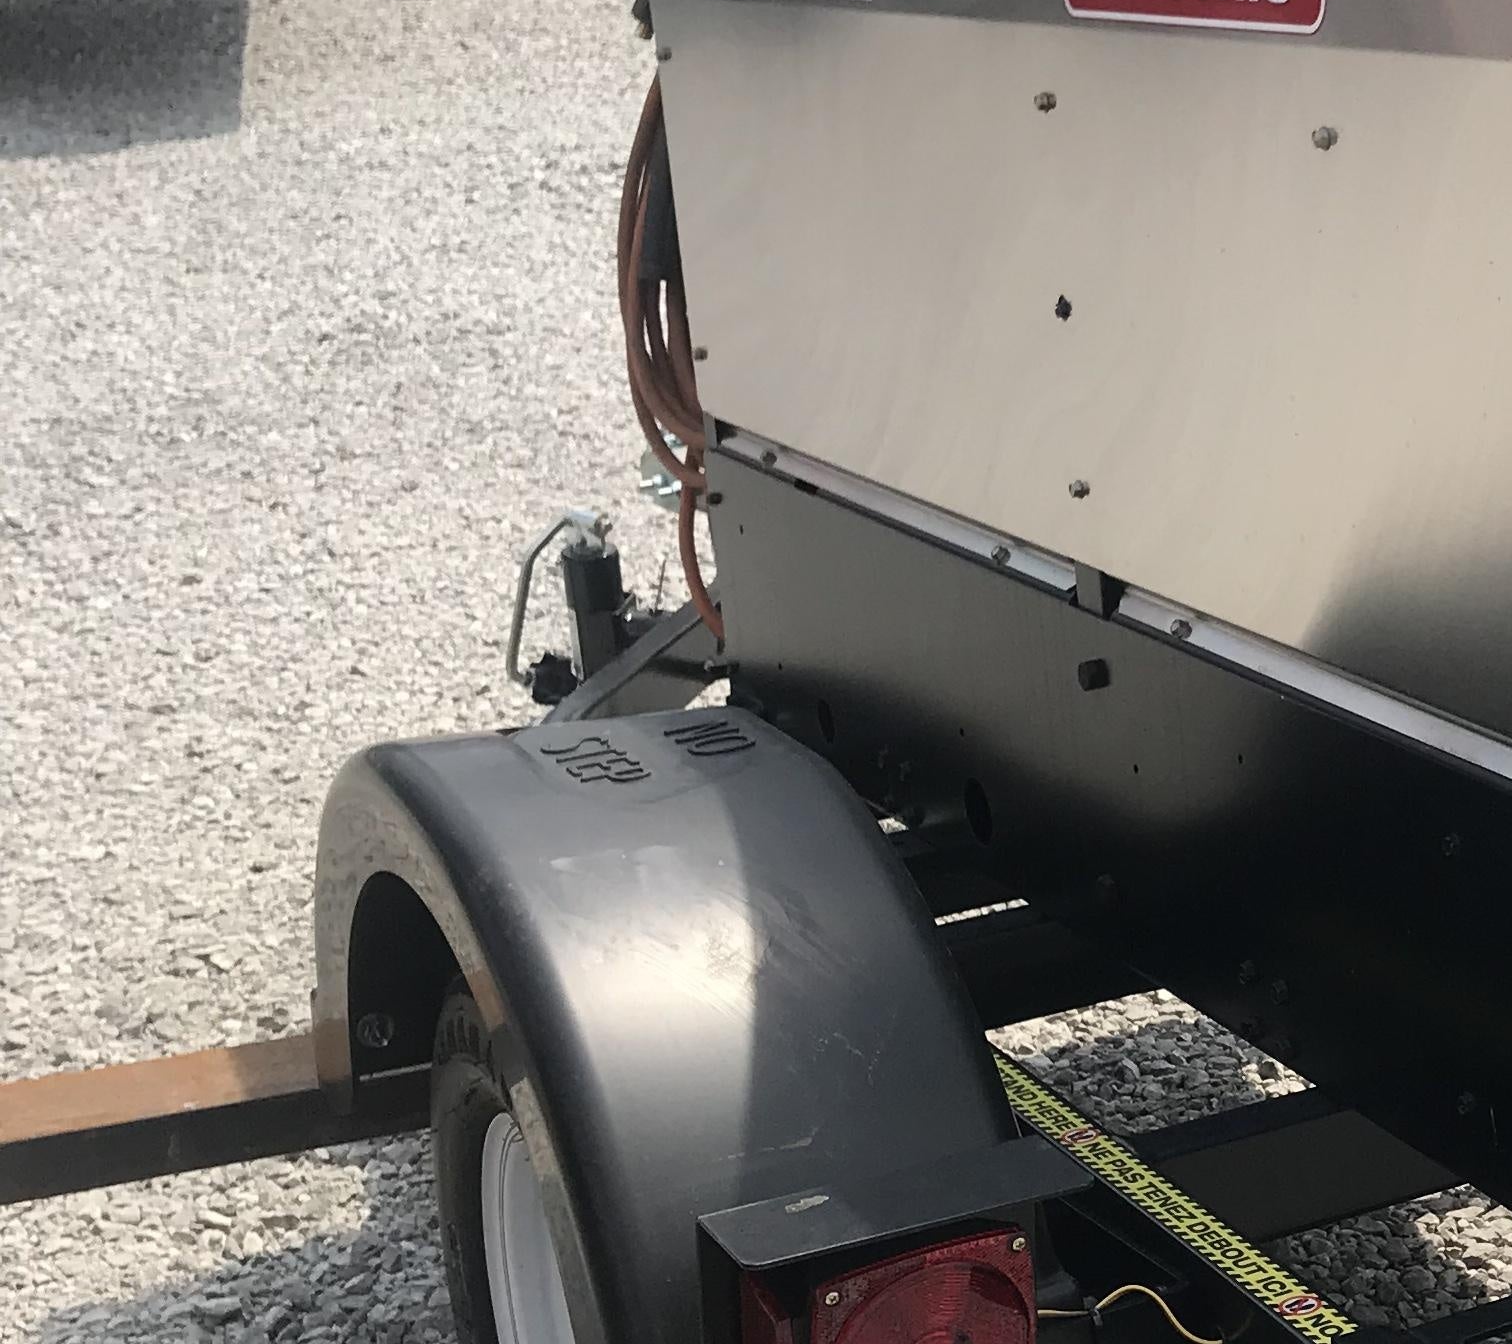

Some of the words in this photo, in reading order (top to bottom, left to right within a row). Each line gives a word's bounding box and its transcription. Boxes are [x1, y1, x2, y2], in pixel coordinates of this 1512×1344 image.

[1001, 1071, 1039, 1102] TAND
[1028, 1099, 1078, 1131] HERE
[1082, 1141, 1115, 1160] NE
[1105, 1158, 1146, 1184] PAS
[1139, 1181, 1198, 1223] TENEZ
[1186, 1222, 1270, 1279] DEBOUT
[1256, 1275, 1293, 1297] ICI
[1309, 1313, 1345, 1339] NO
